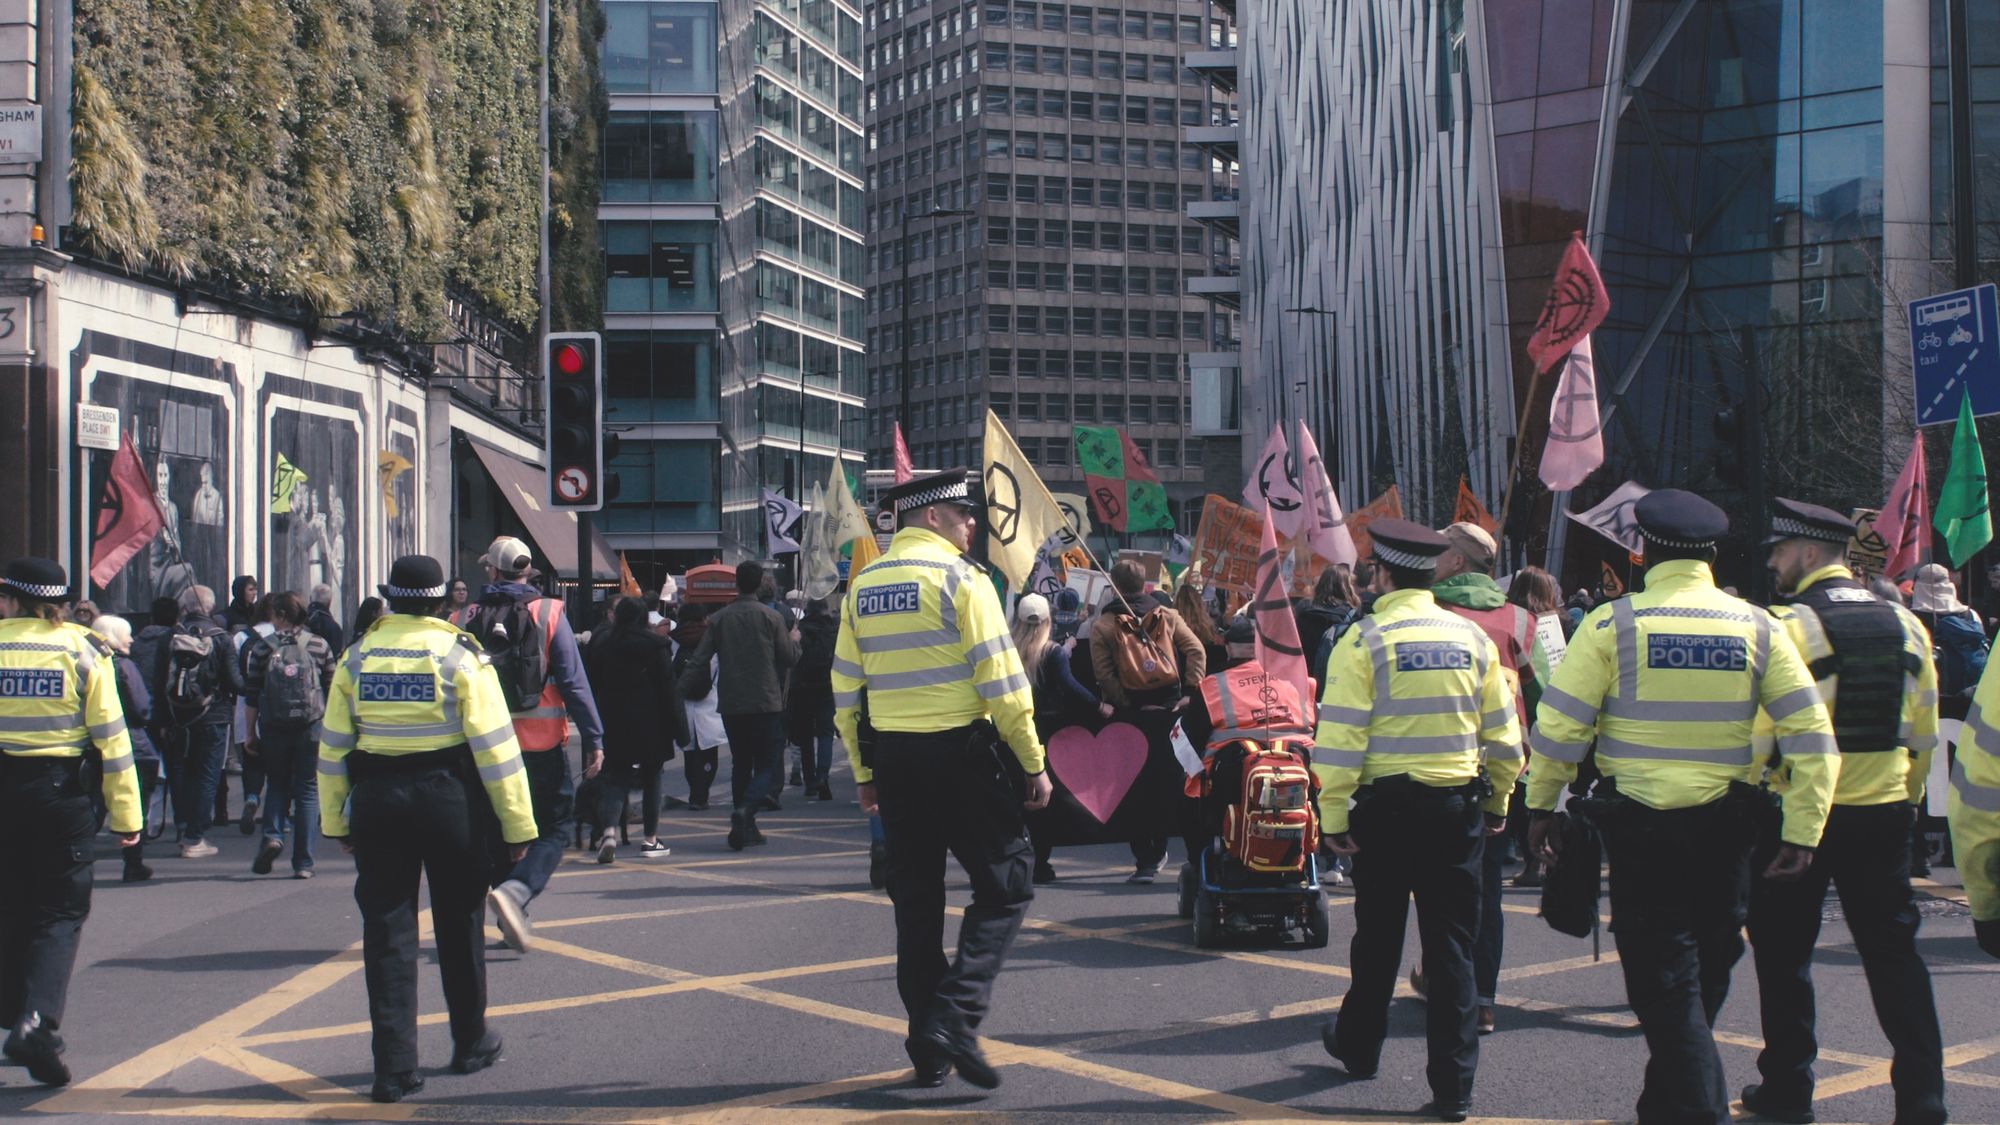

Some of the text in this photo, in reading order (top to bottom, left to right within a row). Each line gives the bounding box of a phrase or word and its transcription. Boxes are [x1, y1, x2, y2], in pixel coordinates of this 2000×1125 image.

[1920, 353, 1938, 366] taxi
[82, 409, 117, 423] BRESSENDEN
[82, 421, 99, 434] PLACE
[859, 584, 918, 597] METROPOLITAN
[858, 591, 917, 615] POLICE
[1649, 636, 1745, 648] METROPOLITAN
[1398, 650, 1470, 669] POLICE
[1649, 647, 1745, 669] POLICE
[361, 674, 435, 684] METROPOLITAN
[0, 678, 62, 696] OLICE
[361, 682, 435, 700] POLICE
